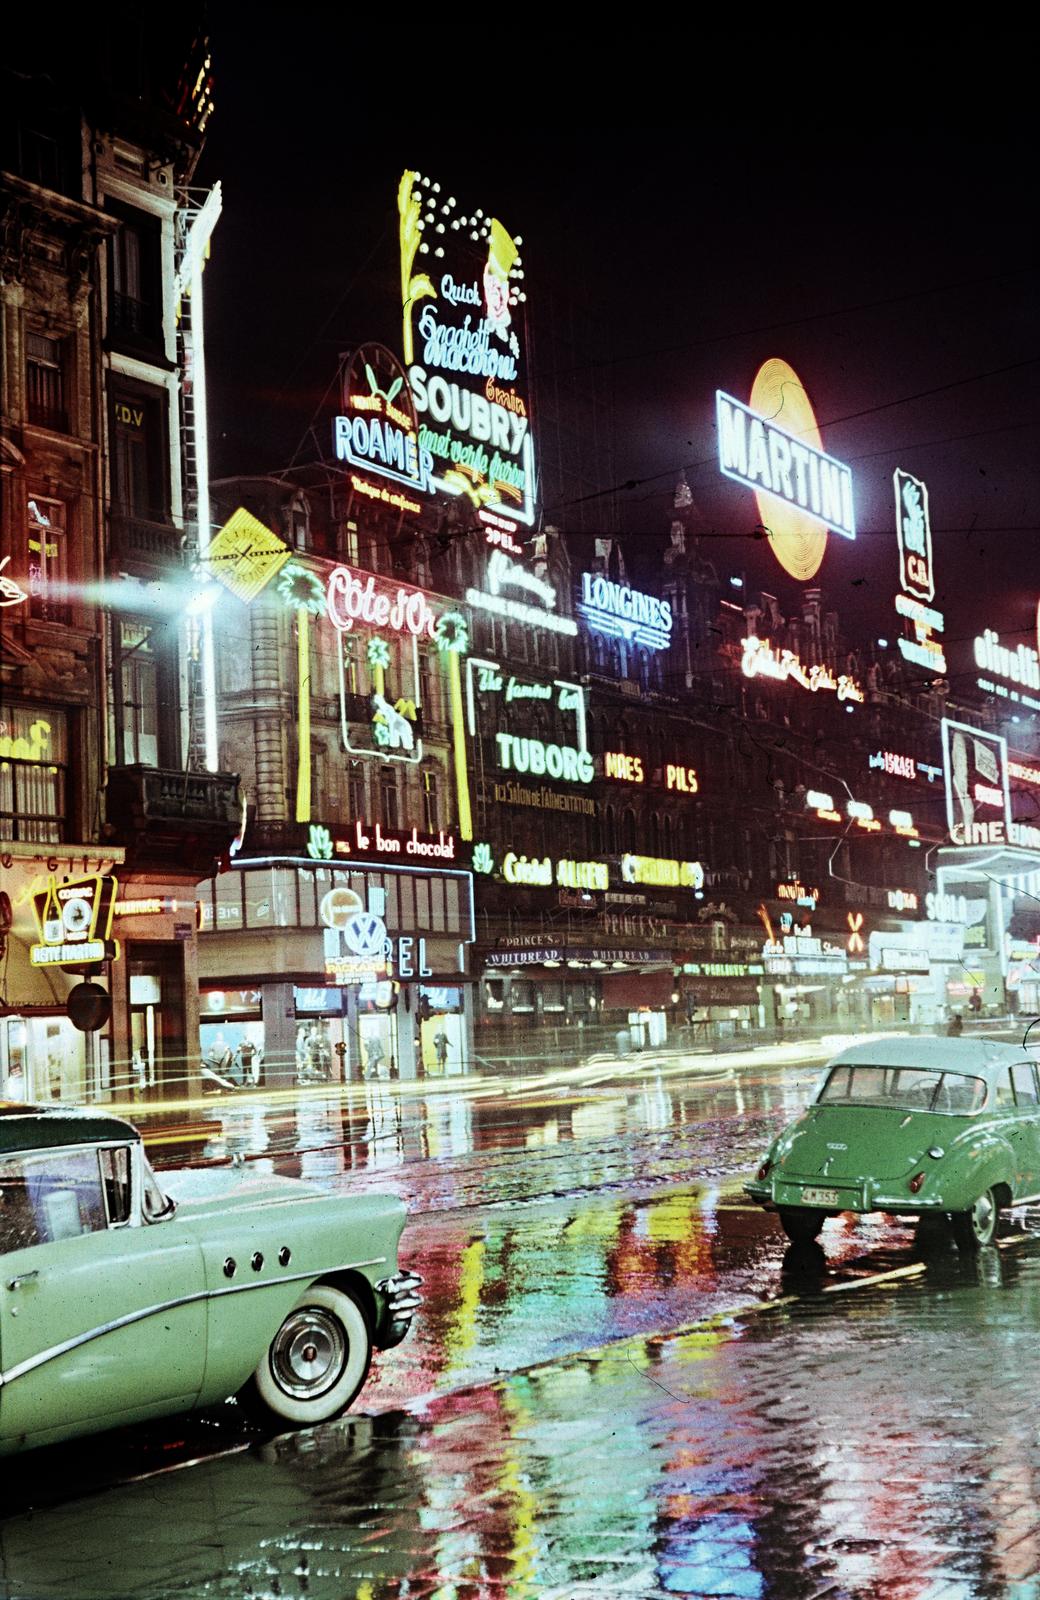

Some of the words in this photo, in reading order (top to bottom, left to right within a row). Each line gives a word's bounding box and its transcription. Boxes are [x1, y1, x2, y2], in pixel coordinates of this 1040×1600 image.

[440, 273, 482, 306] Quick
[418, 304, 491, 350] Spaghetti
[408, 364, 528, 455] SOUBRY
[485, 376, 495, 398] 6
[496, 388, 526, 416] min
[335, 415, 436, 495] ROAMER
[720, 399, 852, 537] MARTINI
[327, 566, 389, 632] Côte
[390, 589, 439, 642] d'Or
[582, 571, 673, 632] LONGINES
[478, 669, 503, 691] The
[506, 676, 552, 702] famous
[496, 732, 594, 783] TUBORG
[604, 751, 644, 782] MAES
[666, 764, 698, 793] PILS
[884, 751, 916, 779] ISRAEL
[356, 821, 370, 850] le
[375, 823, 400, 853] bon
[406, 828, 454, 859] chocolat
[326, 963, 386, 973] PACKARD
[490, 949, 559, 963] WHITBREAD
[592, 949, 651, 960] WHITBREAD
